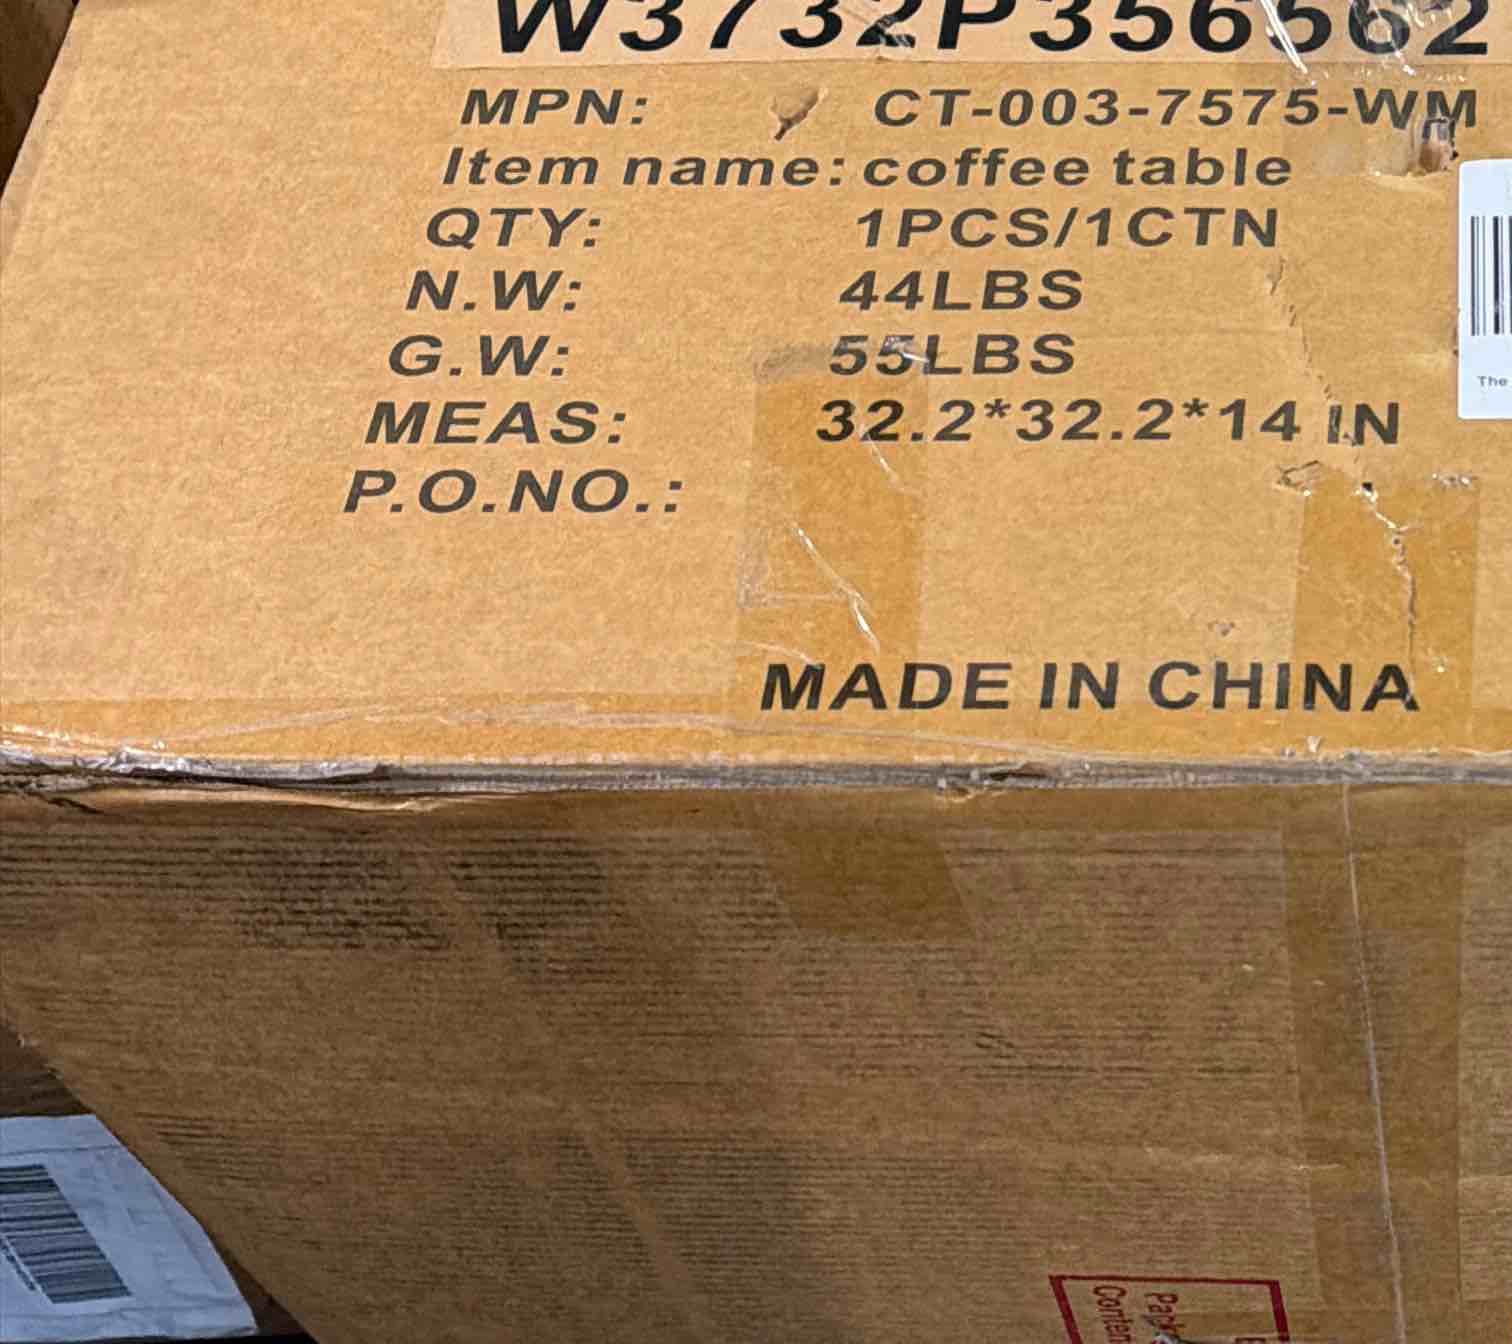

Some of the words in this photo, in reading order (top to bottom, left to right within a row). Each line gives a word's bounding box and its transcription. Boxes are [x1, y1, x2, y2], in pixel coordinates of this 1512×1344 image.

[460, 88, 648, 126] MPN:
[873, 87, 1478, 128] CT-003-7575-WM
[442, 147, 598, 186] Item
[622, 155, 842, 187] name:
[862, 147, 1090, 187] coffee
[1113, 147, 1292, 187] table
[425, 207, 601, 249] QTY:
[855, 207, 1278, 249] 1PCS/1CTN
[404, 269, 582, 312] N.W:
[838, 269, 1083, 312] 44LBS
[386, 334, 570, 377] G.W:
[828, 333, 1077, 376] 55LBS
[1477, 375, 1508, 388] The
[363, 400, 627, 444] MEAS:
[1326, 402, 1401, 445] IN
[343, 469, 683, 514] P.O.NO.:
[758, 662, 1010, 712] MADE
[1038, 662, 1118, 711] IN
[1147, 661, 1421, 712] CHINA
